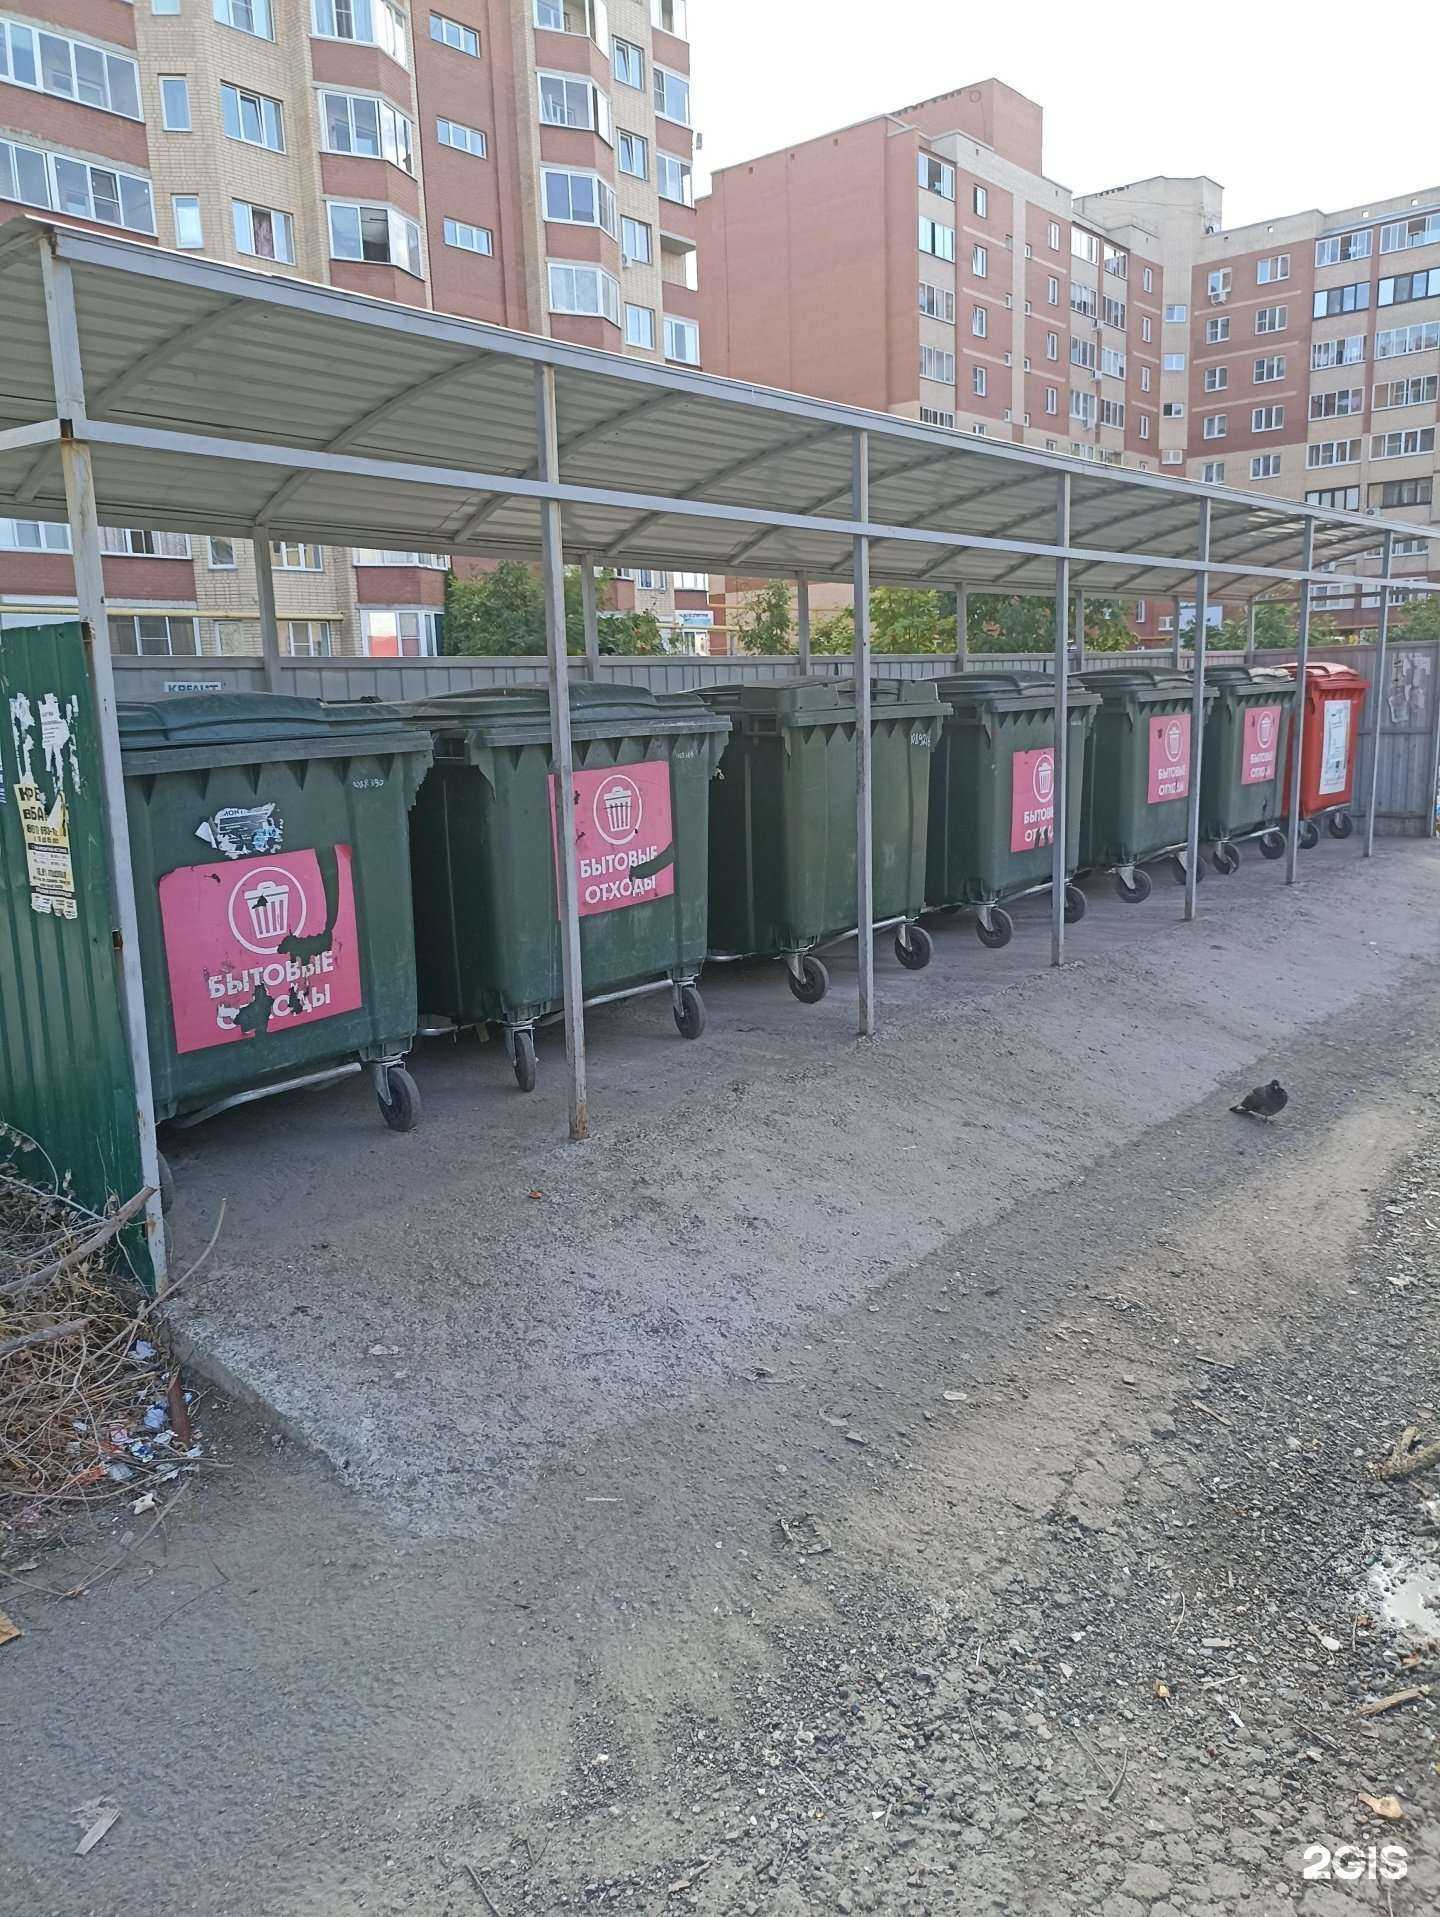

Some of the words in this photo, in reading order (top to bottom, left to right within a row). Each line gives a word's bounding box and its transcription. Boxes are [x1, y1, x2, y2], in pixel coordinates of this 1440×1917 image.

[580, 846, 658, 878] БЫТОВЫЕ
[585, 875, 656, 904] ОТХОДЫ
[208, 951, 334, 999] БЫТОВЫЕ
